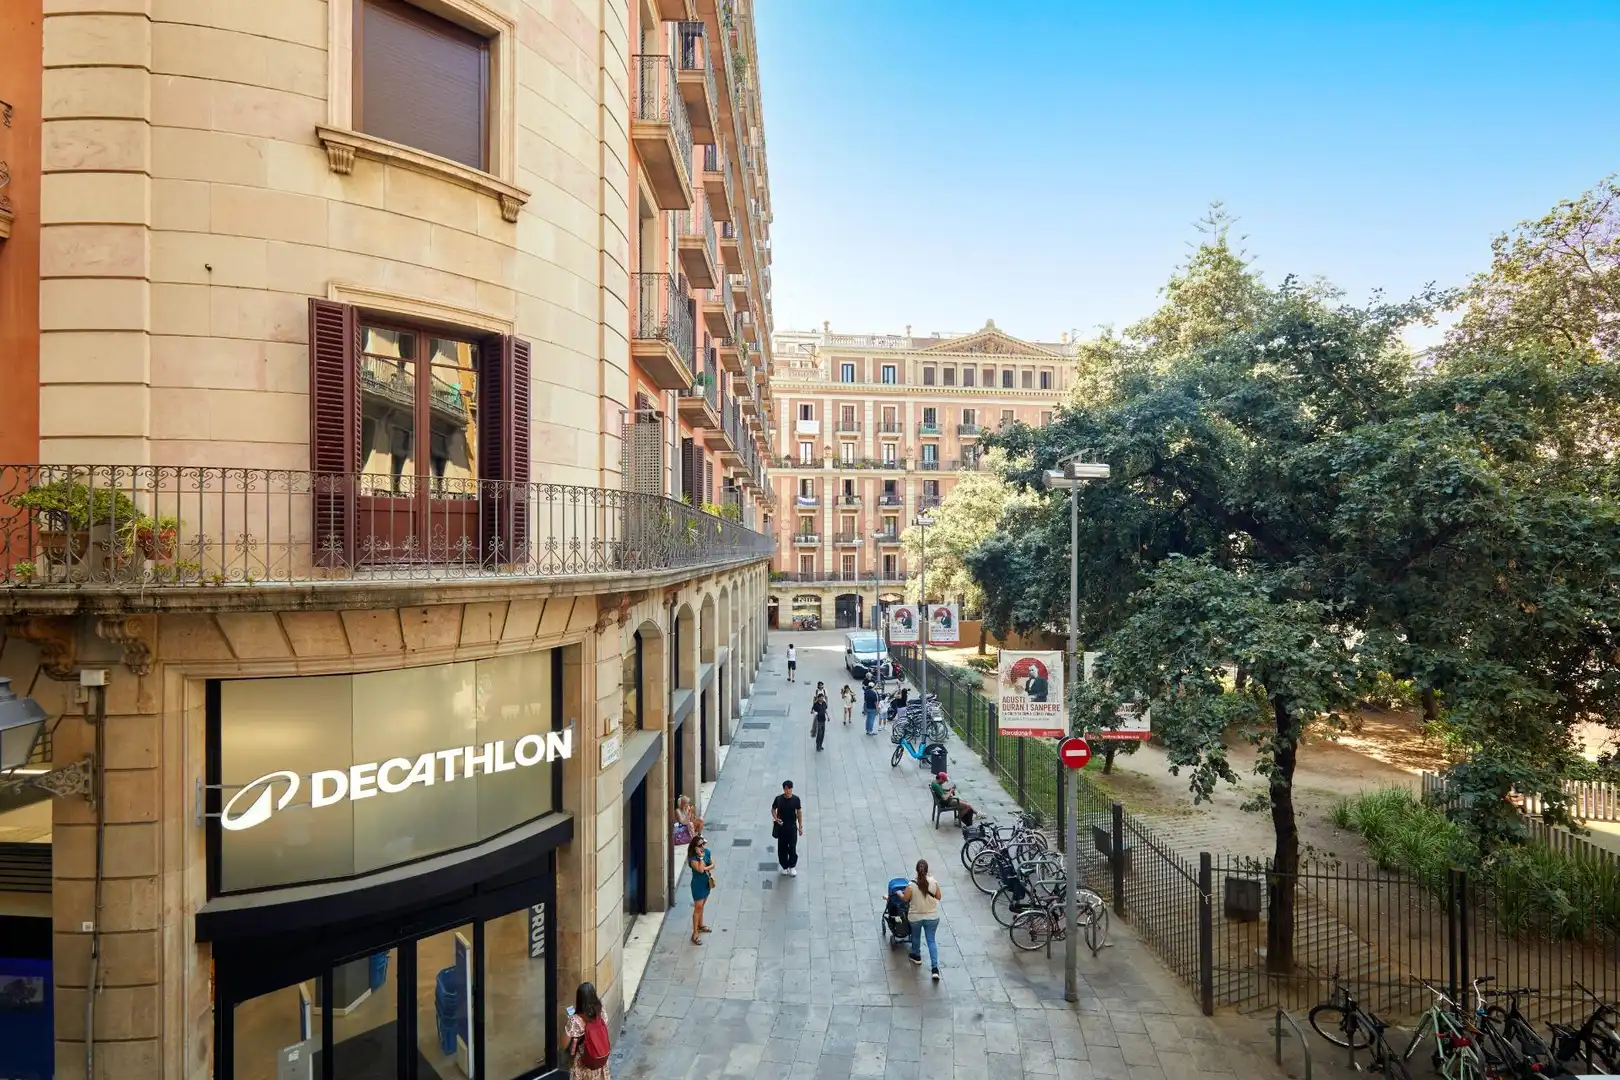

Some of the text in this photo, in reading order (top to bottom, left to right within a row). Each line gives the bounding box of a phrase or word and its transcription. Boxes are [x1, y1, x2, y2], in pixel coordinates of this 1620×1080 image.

[1002, 703, 1024, 711] DURAN
[1030, 703, 1061, 712] SANPERE
[311, 728, 572, 808] DECATHLON
[532, 901, 545, 958] PRUN
